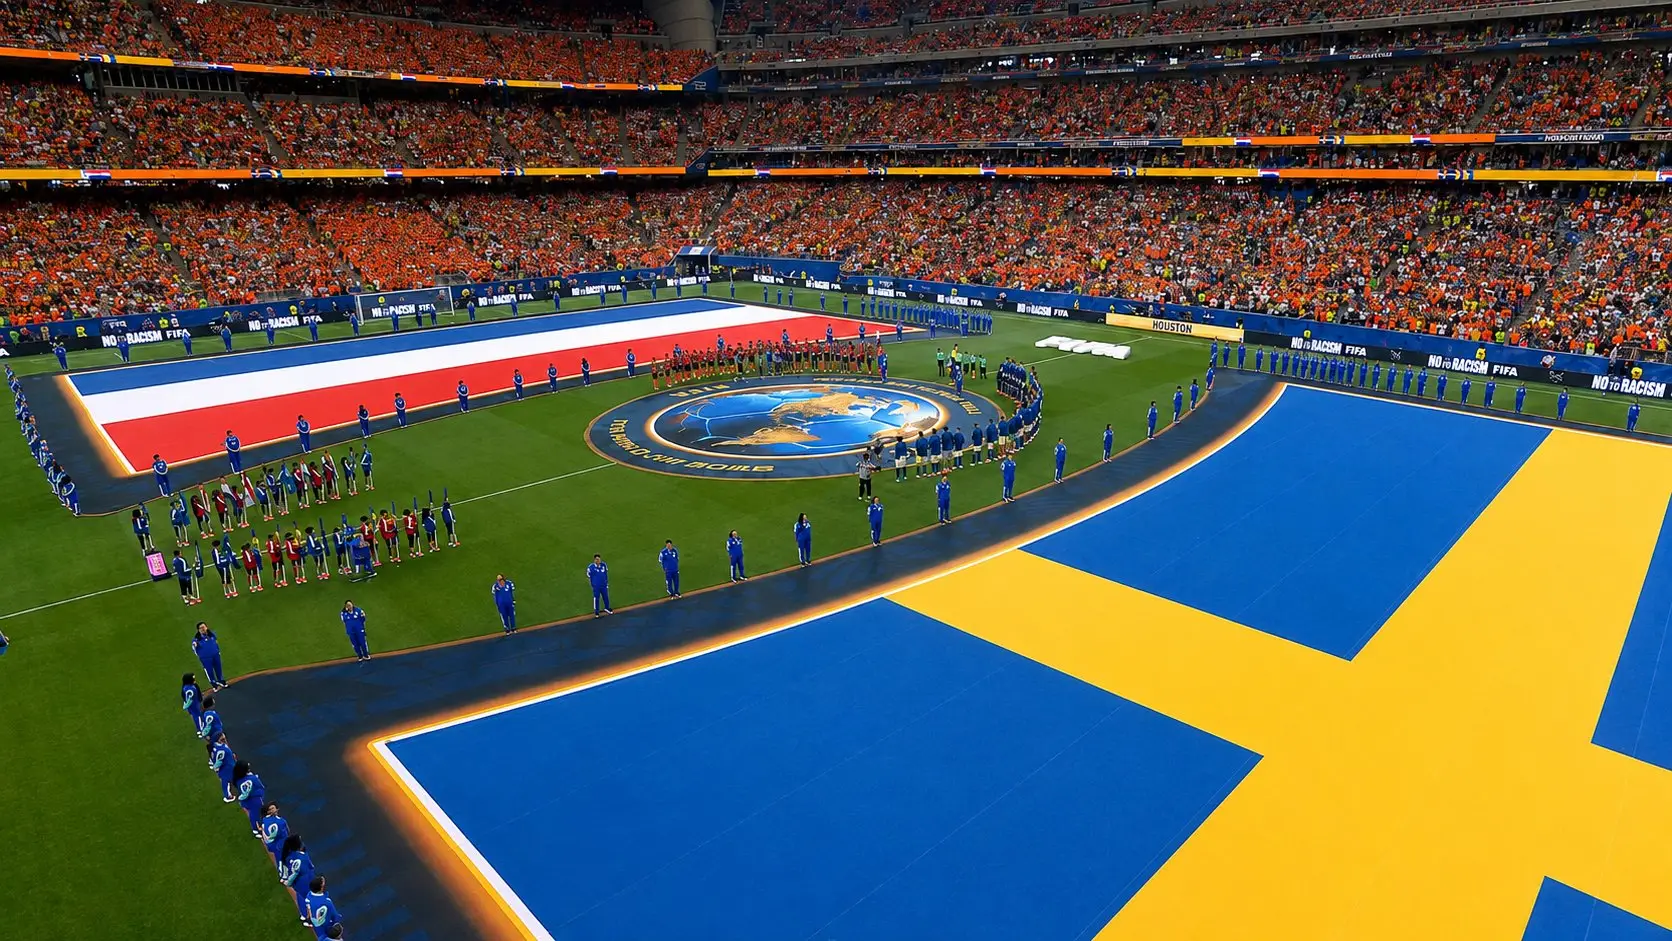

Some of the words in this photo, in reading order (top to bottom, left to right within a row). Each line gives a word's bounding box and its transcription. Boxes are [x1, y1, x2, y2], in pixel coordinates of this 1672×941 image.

[1152, 320, 1193, 333] HOUSTON
[101, 335, 118, 348] NO
[125, 330, 163, 345] RACISM
[166, 328, 191, 339] FIFA
[1290, 336, 1304, 349] NO
[1310, 339, 1343, 355] RACISM
[1345, 345, 1367, 356] FIFA
[1427, 354, 1443, 368] NO
[1451, 358, 1489, 375] RACISM
[1492, 364, 1518, 377] FIFA
[1591, 375, 1610, 390] NO
[1609, 381, 1621, 391] TO
[1620, 378, 1667, 397] RACISM
